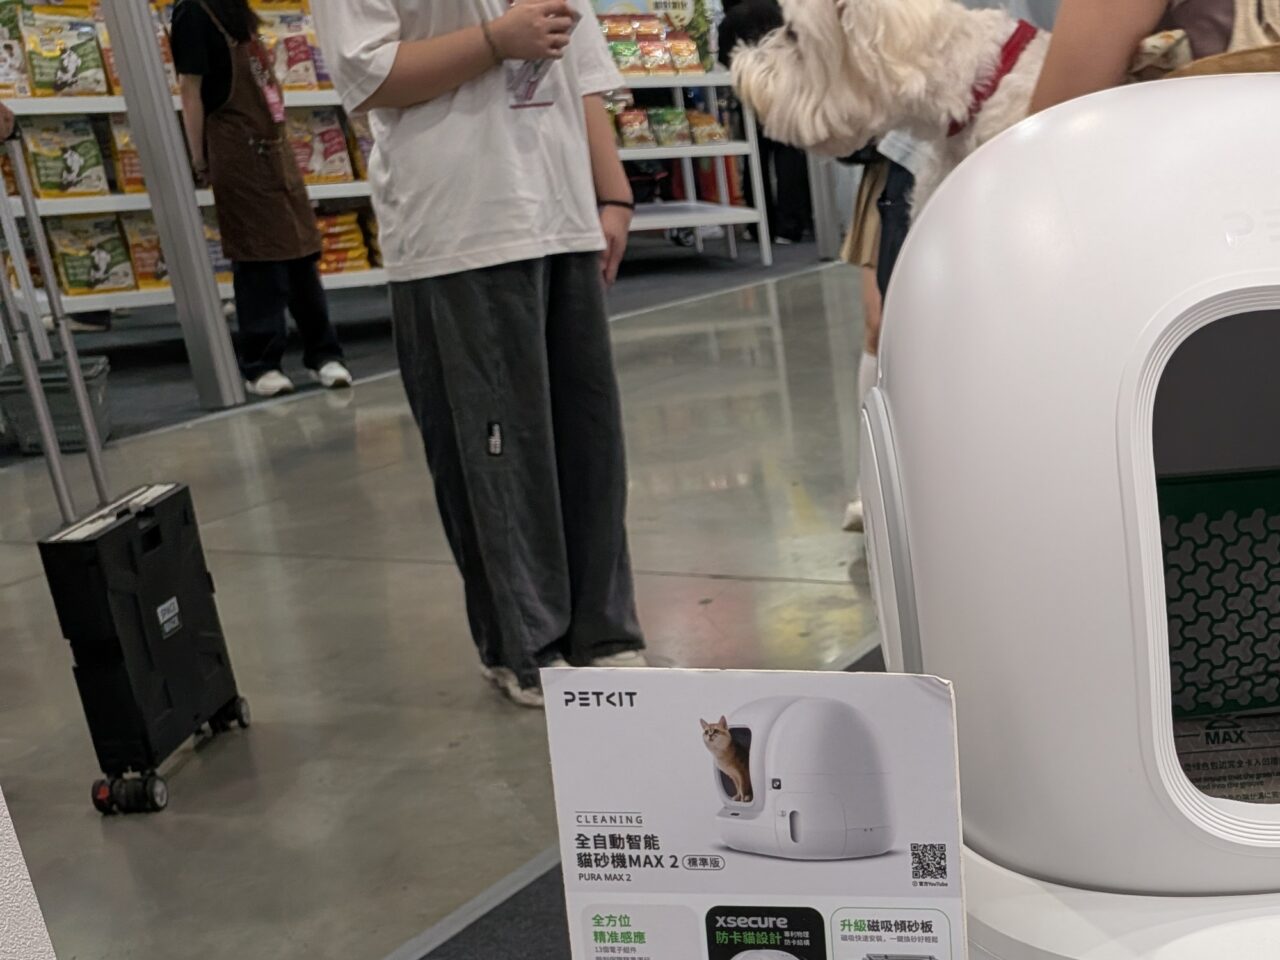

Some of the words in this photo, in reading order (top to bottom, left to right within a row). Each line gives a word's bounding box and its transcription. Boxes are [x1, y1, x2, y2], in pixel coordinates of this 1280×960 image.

[563, 691, 637, 707] PETKIT
[1205, 729, 1246, 746] MAX
[576, 814, 643, 825] CLEANING
[574, 833, 661, 851] 全自動智能
[576, 852, 665, 869] 貓砂機MAX
[669, 854, 680, 868] 2
[578, 873, 602, 881] PURA
[604, 873, 624, 882] MAX
[626, 873, 632, 882] 2
[592, 913, 631, 928] 全方位
[715, 915, 788, 929] xsecure
[840, 919, 934, 934] 升級磁吸傾砂板
[715, 931, 782, 945] 防卡貓設計
